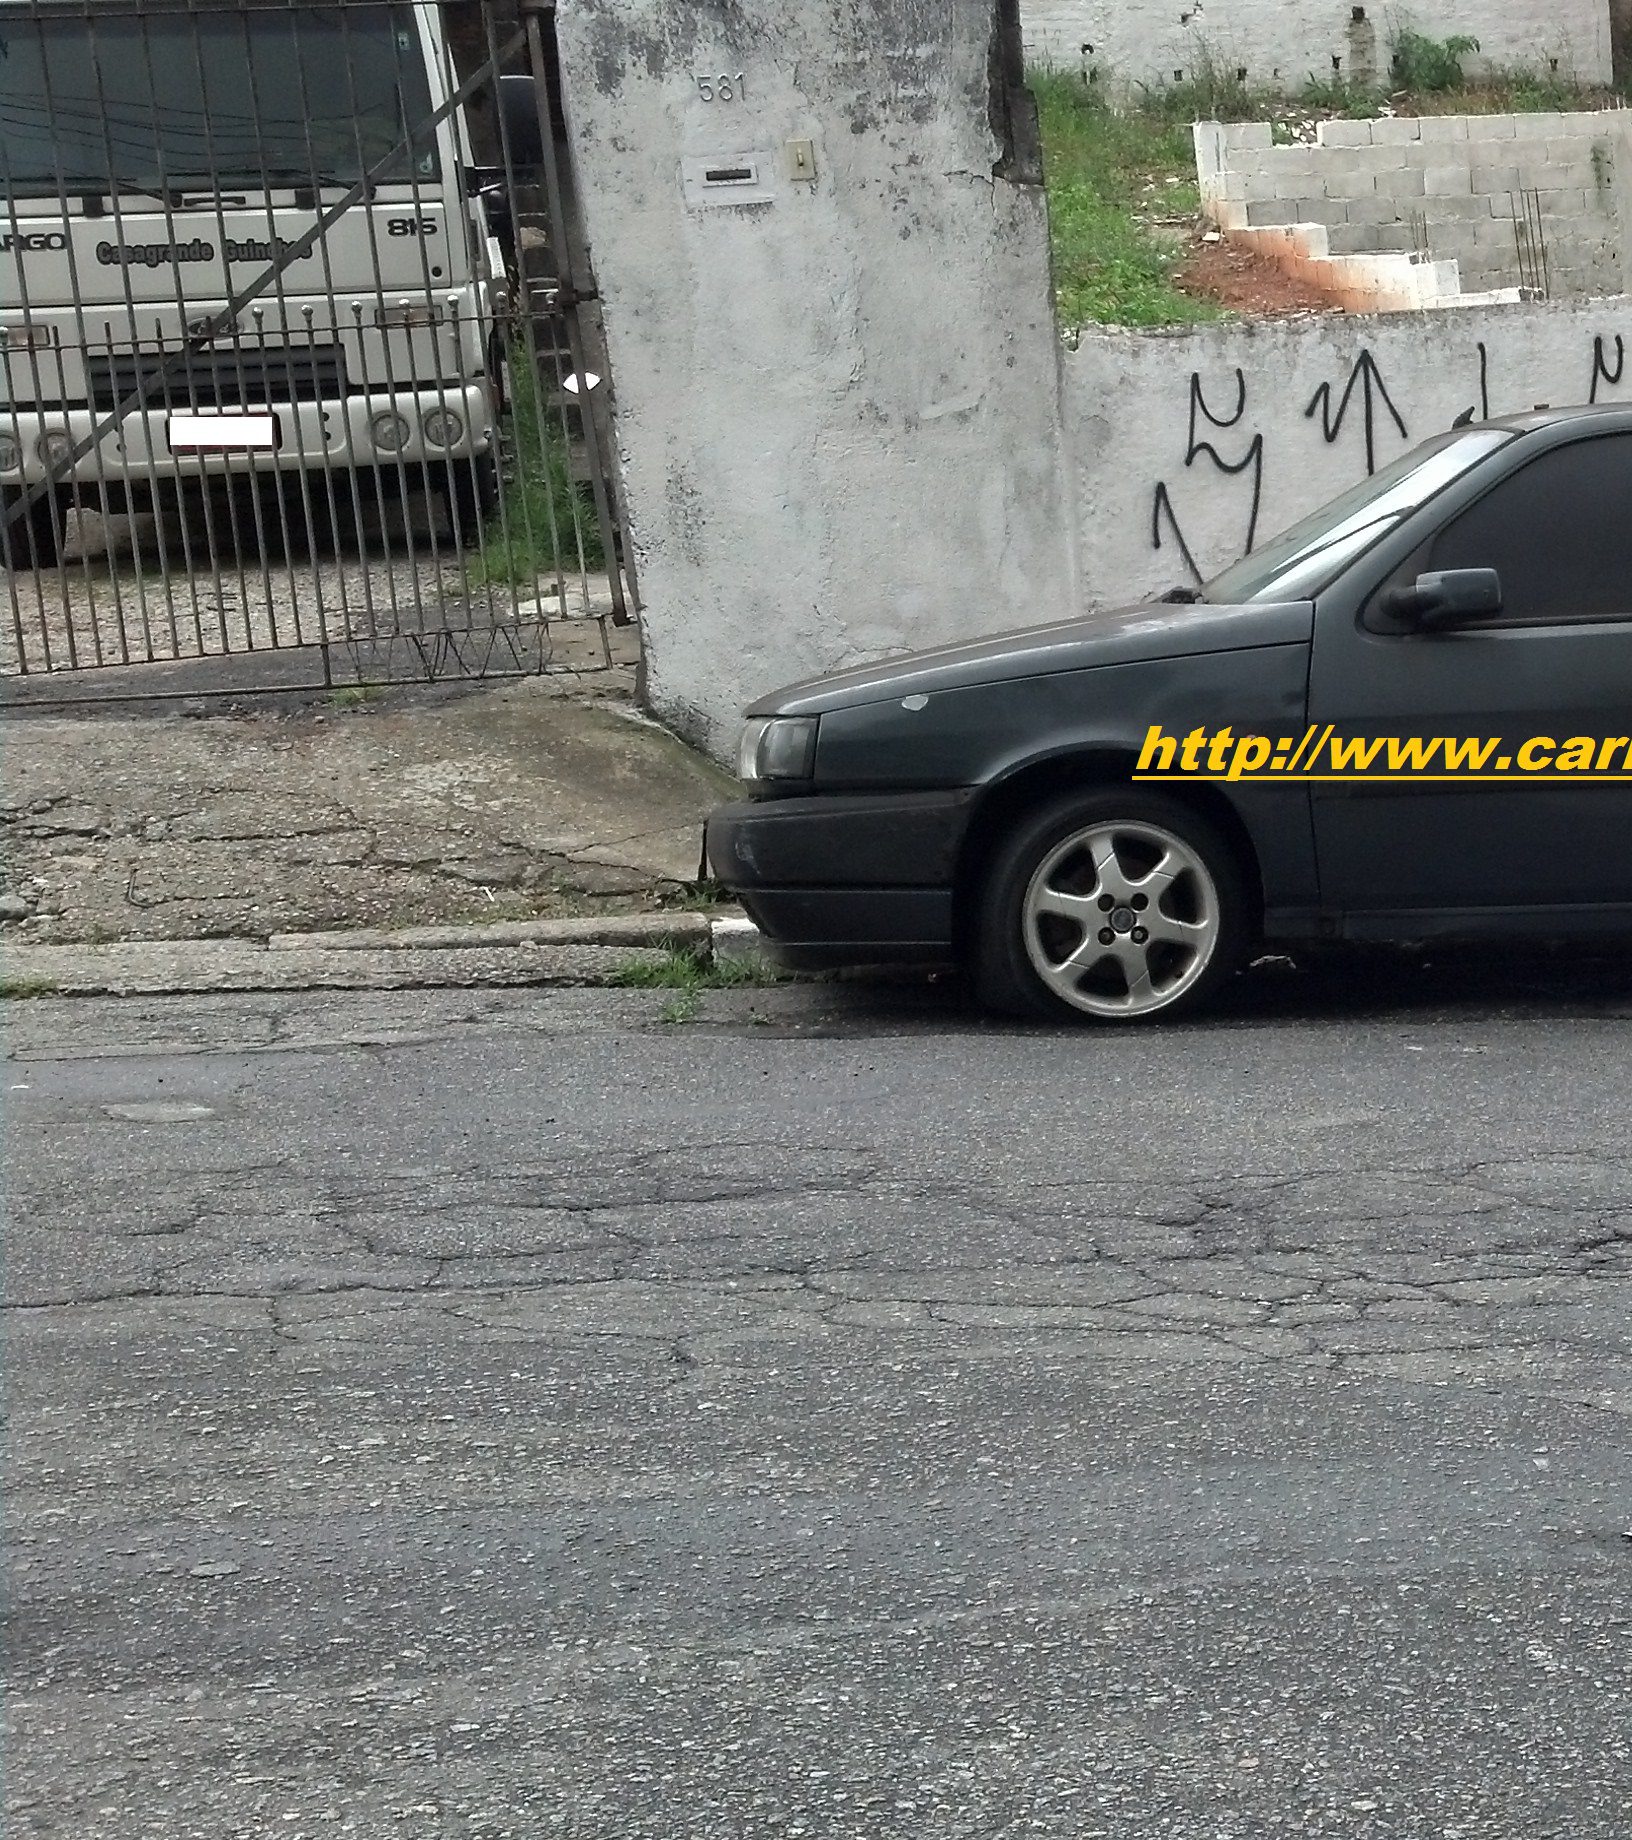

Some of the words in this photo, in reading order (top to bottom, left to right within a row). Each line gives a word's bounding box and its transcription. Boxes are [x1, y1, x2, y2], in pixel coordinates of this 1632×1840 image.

[697, 72, 746, 102] 581
[387, 217, 438, 236] 815
[96, 238, 214, 268] Casagrande
